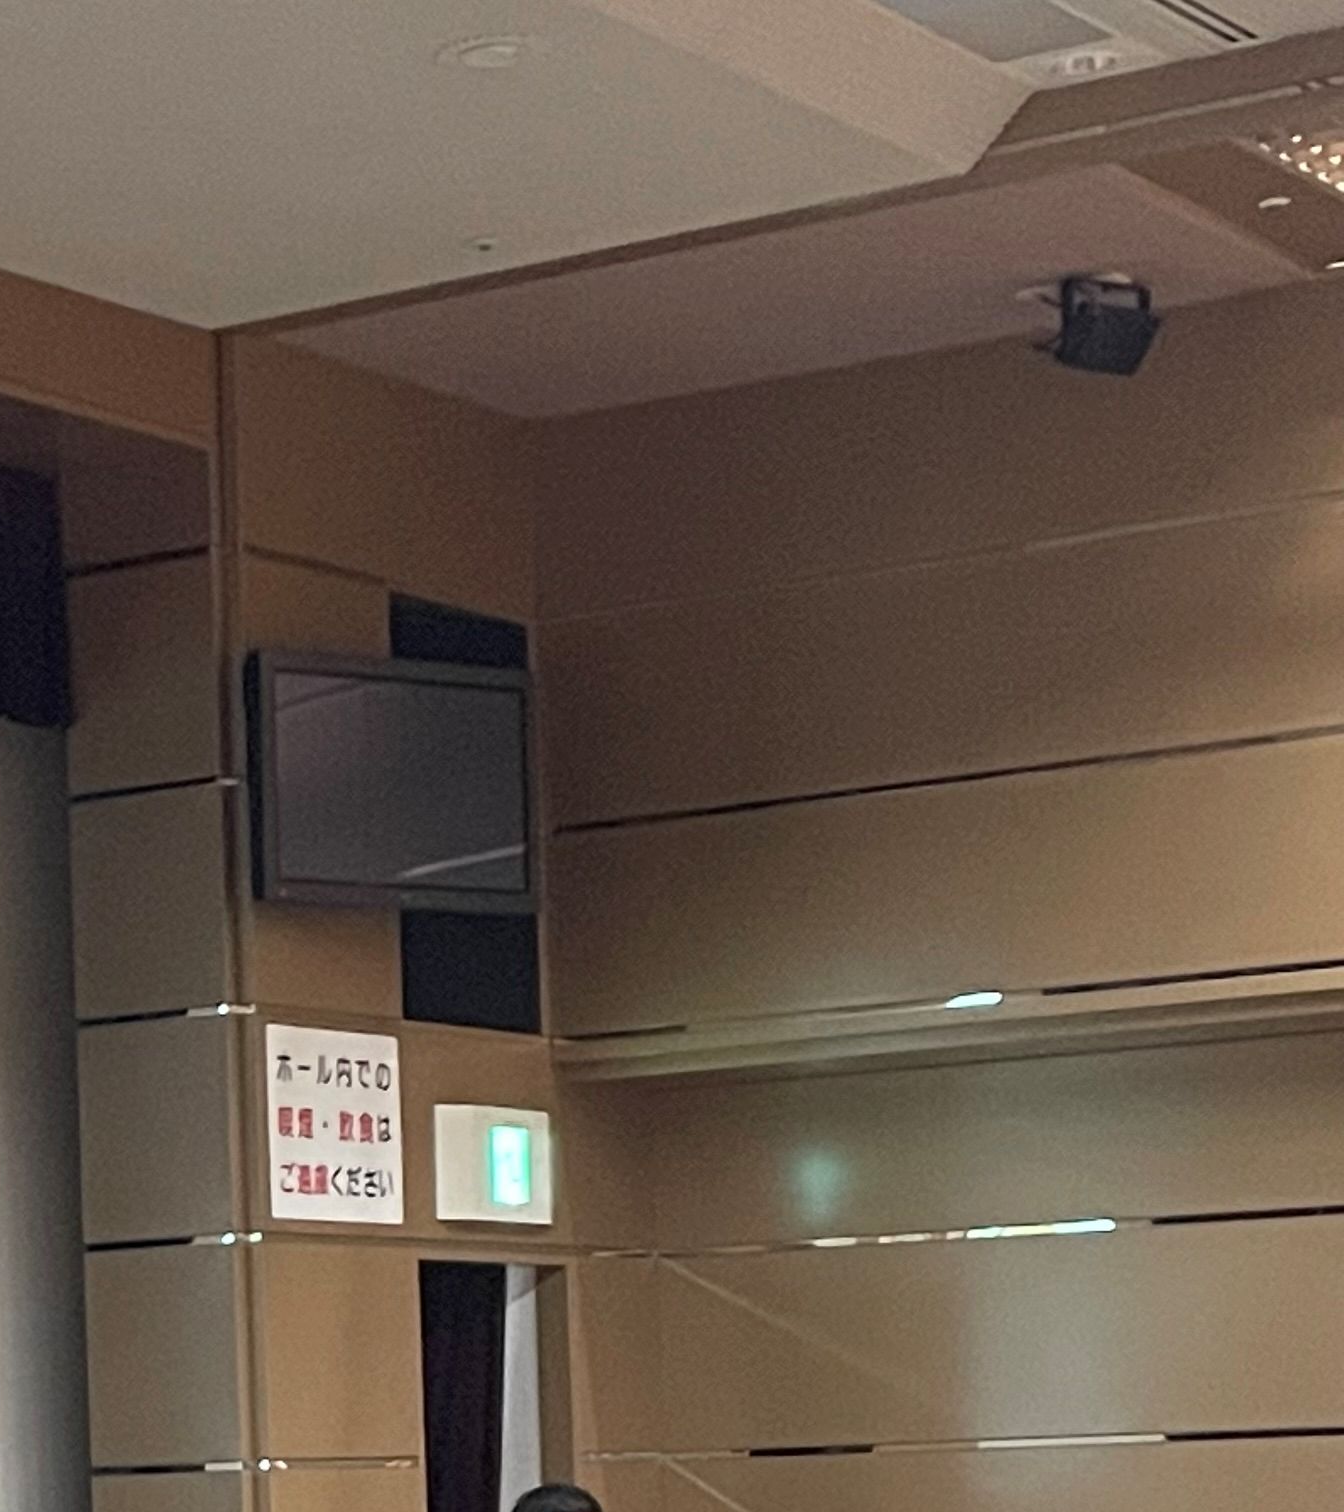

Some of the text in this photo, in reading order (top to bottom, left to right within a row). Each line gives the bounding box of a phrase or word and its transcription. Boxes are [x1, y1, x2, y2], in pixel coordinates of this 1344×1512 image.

[276, 1055, 391, 1091] ホール内での
